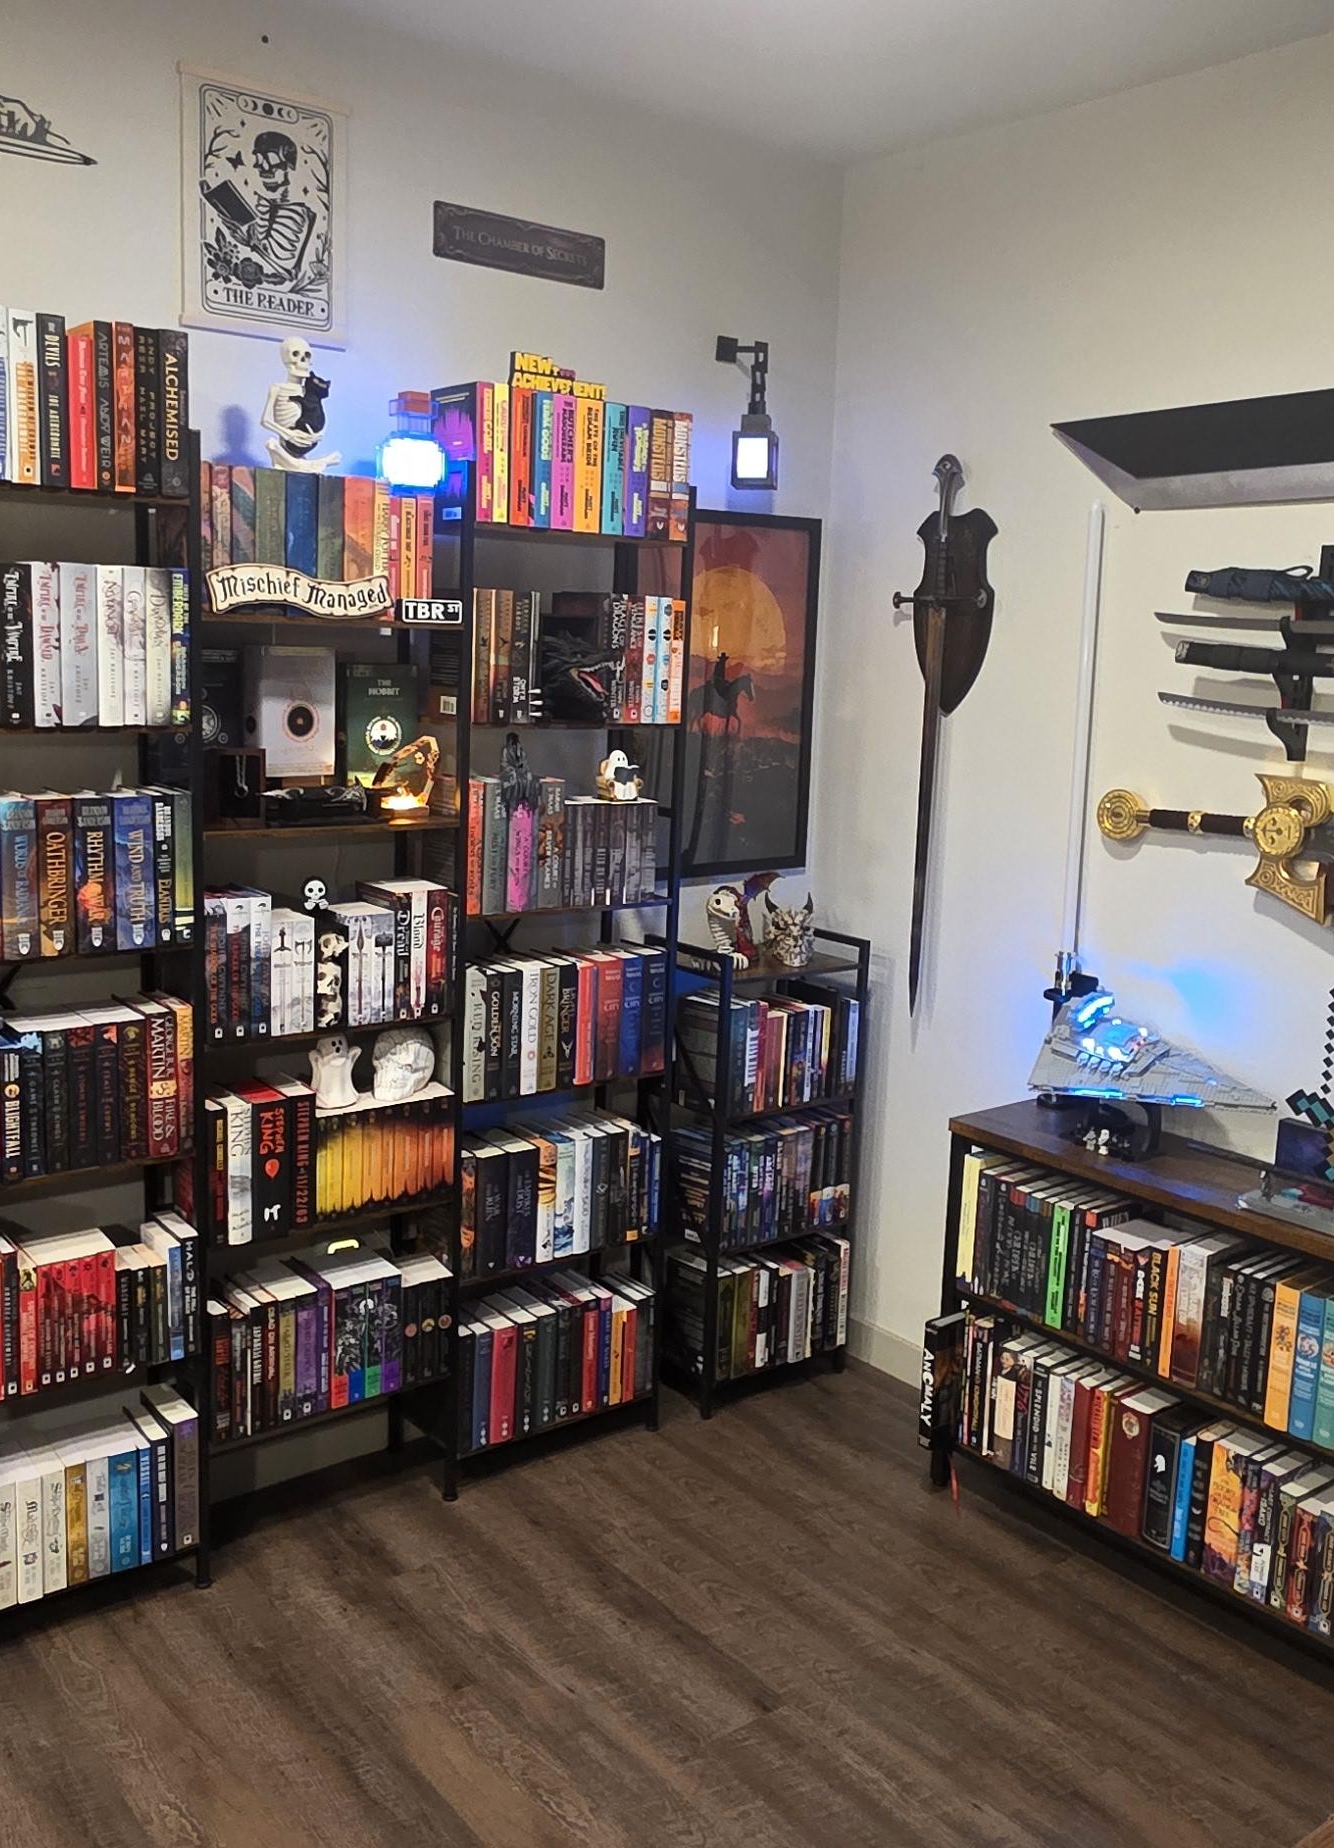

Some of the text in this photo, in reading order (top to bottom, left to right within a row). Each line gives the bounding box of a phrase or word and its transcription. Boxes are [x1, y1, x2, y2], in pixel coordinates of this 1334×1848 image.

[453, 225, 475, 241] THE
[478, 231, 530, 255] CHAMBER
[224, 287, 315, 317] THE READER
[45, 334, 61, 368] DEVILS
[515, 352, 552, 374] NEW
[98, 332, 111, 468] ARTEMIS WEIR
[164, 353, 178, 461] ALCHEMISED
[566, 409, 574, 464] BUTCHER'S
[592, 441, 598, 452] OF
[217, 572, 388, 611] Mischief Managed
[404, 602, 460, 620] TBR ST
[611, 602, 620, 649] DRAGONS
[368, 687, 400, 696] HOBBIT
[87, 832, 104, 882] RHYTHM
[128, 830, 143, 863] WIND
[46, 832, 67, 925] OATHBRINGER
[129, 884, 146, 922] TRUTH
[396, 910, 411, 957] Dread
[413, 913, 426, 950] Blood
[432, 907, 446, 952] Courage
[472, 1003, 483, 1031] RED
[490, 991, 500, 1056] GOLDEN SON
[509, 991, 520, 1058] MORNING STAR
[528, 973, 539, 1043] IRON GOLD
[544, 973, 556, 1041] DARK AGE
[559, 988, 571, 1034] BRINGER
[151, 1018, 165, 1079] MARTIN
[165, 1016, 173, 1056] GEORGE
[5, 1100, 20, 1158] BLIGHTFALL
[153, 1101, 164, 1141] BLOOD
[166, 1099, 175, 1138] FIRE &
[230, 1111, 243, 1157] KING
[259, 1112, 275, 1155] KING
[274, 1108, 285, 1153] STEPHEN
[296, 1144, 310, 1168] KING
[185, 1240, 195, 1282] HALO
[1148, 1252, 1163, 1316] BLACK SUN
[974, 1342, 984, 1384] BATMAN
[1018, 1383, 1031, 1415] 1776
[1028, 1387, 1042, 1472] SPLENDID VILE
